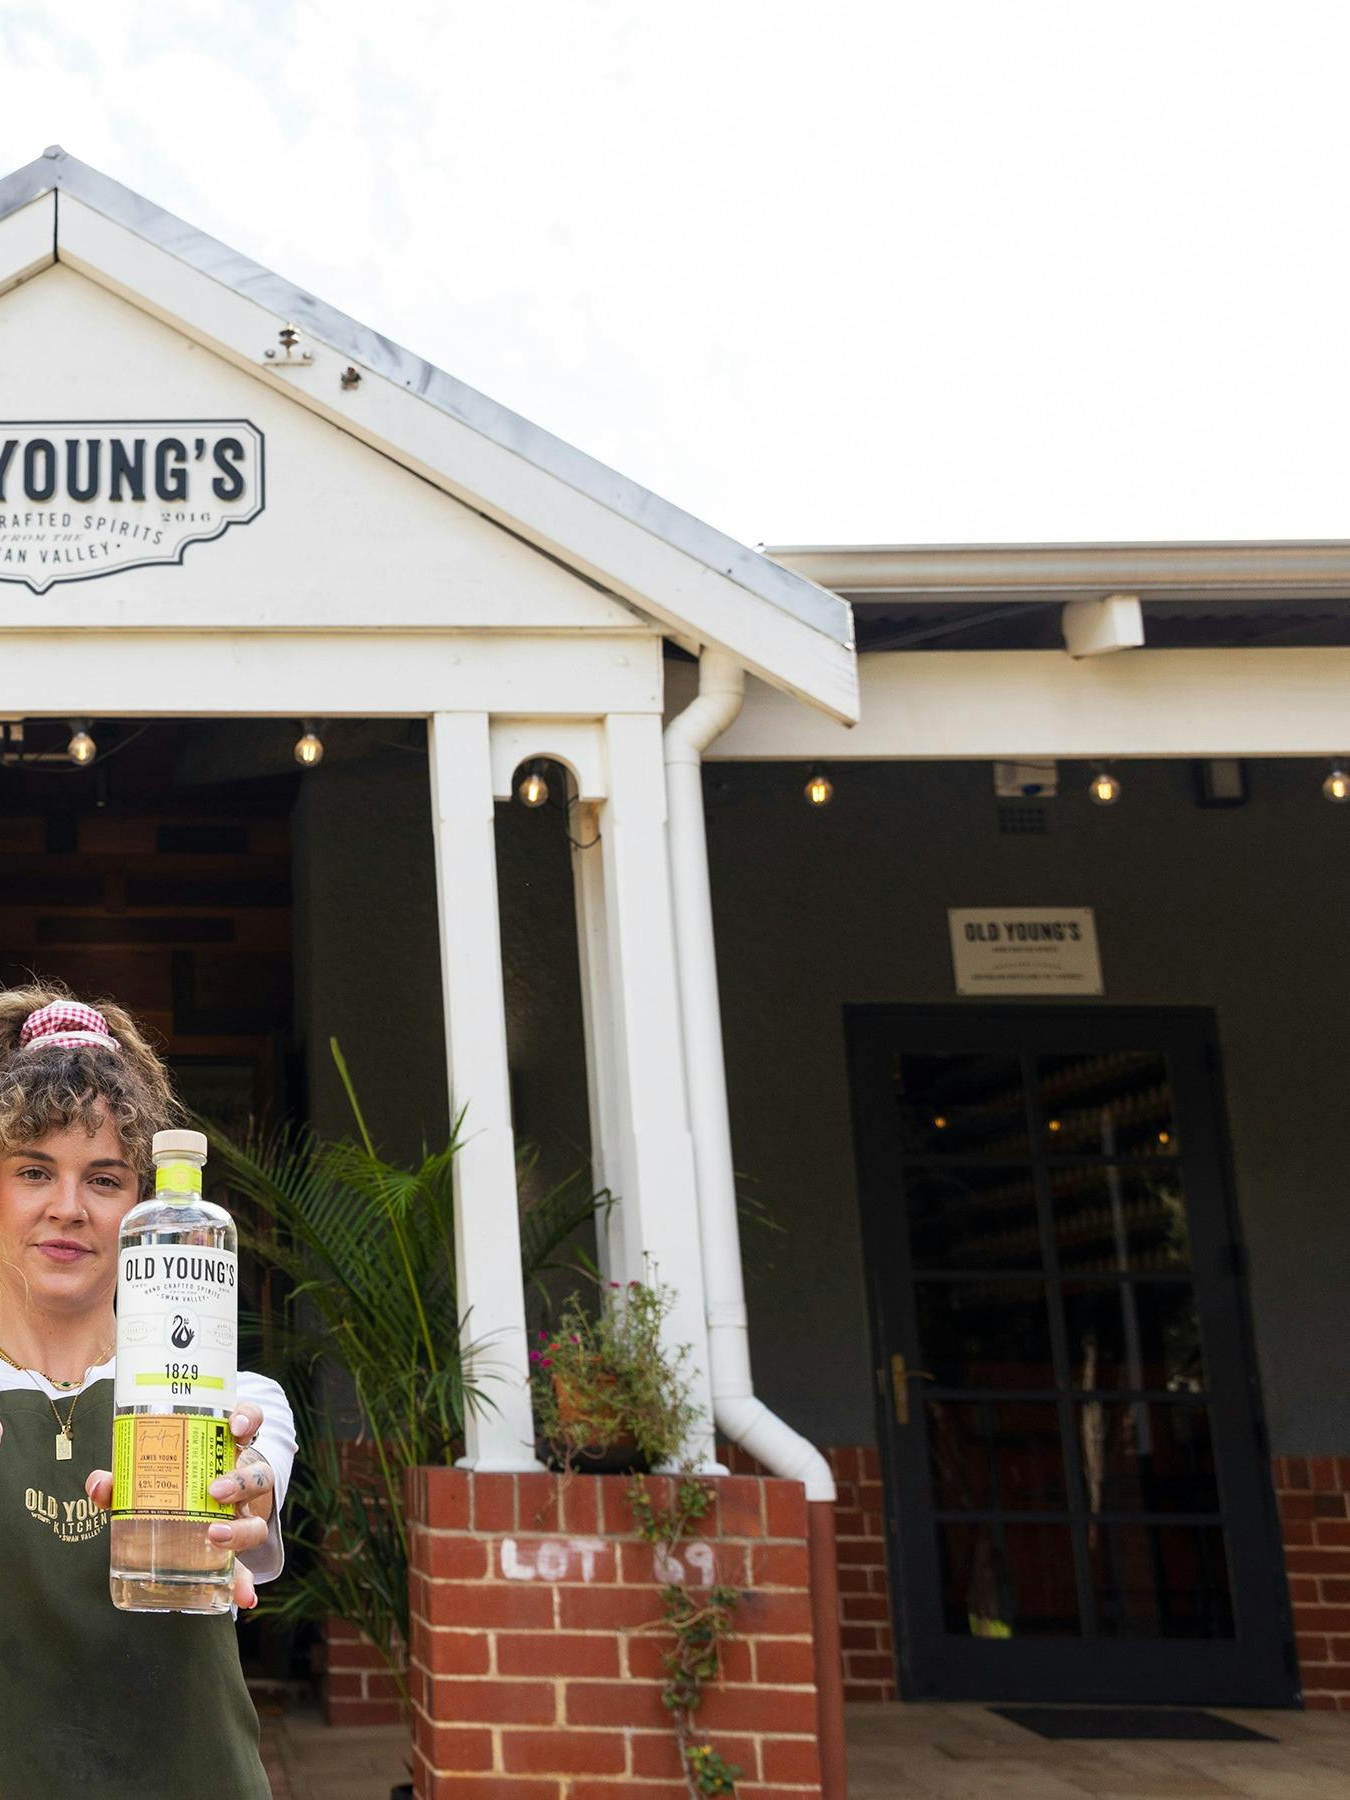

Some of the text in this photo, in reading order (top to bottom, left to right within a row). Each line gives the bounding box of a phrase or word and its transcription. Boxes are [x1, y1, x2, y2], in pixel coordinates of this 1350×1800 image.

[161, 512, 212, 522] 2016
[0, 533, 84, 542] FROM THE
[83, 515, 163, 545] SPIRITS
[39, 542, 109, 564] VALLEY
[964, 921, 1082, 942] OLD YOUNG'S
[125, 1257, 235, 1287] OLD YOUNG'S
[165, 1363, 199, 1380] 1829
[171, 1382, 192, 1395] GIN
[216, 1434, 224, 1478] 182
[25, 1487, 59, 1520] OLD
[53, 1512, 108, 1536] KITCHEN
[81, 1528, 102, 1542] VALLEY
[500, 1537, 607, 1584] LOT
